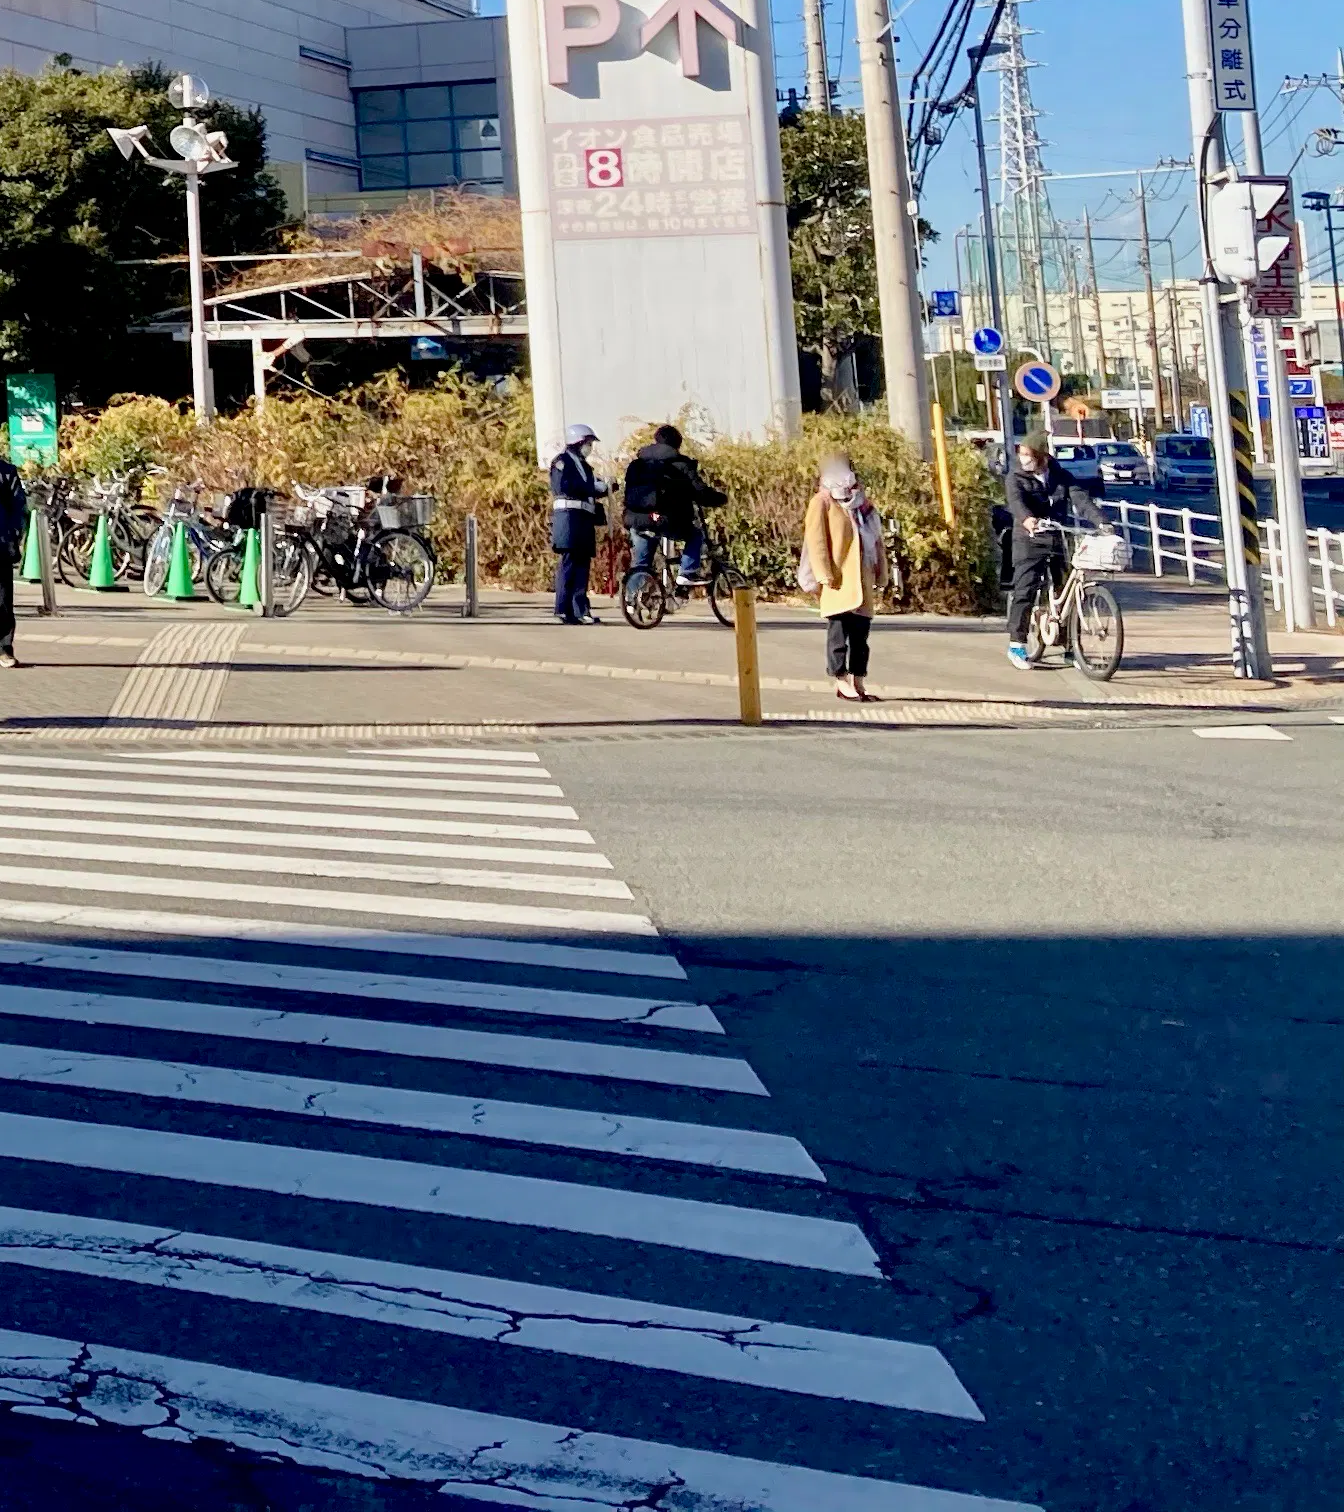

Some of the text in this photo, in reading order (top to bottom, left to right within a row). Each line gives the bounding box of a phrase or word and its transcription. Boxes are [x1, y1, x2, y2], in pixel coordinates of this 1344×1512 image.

[552, 120, 743, 152] イオン食品売場
